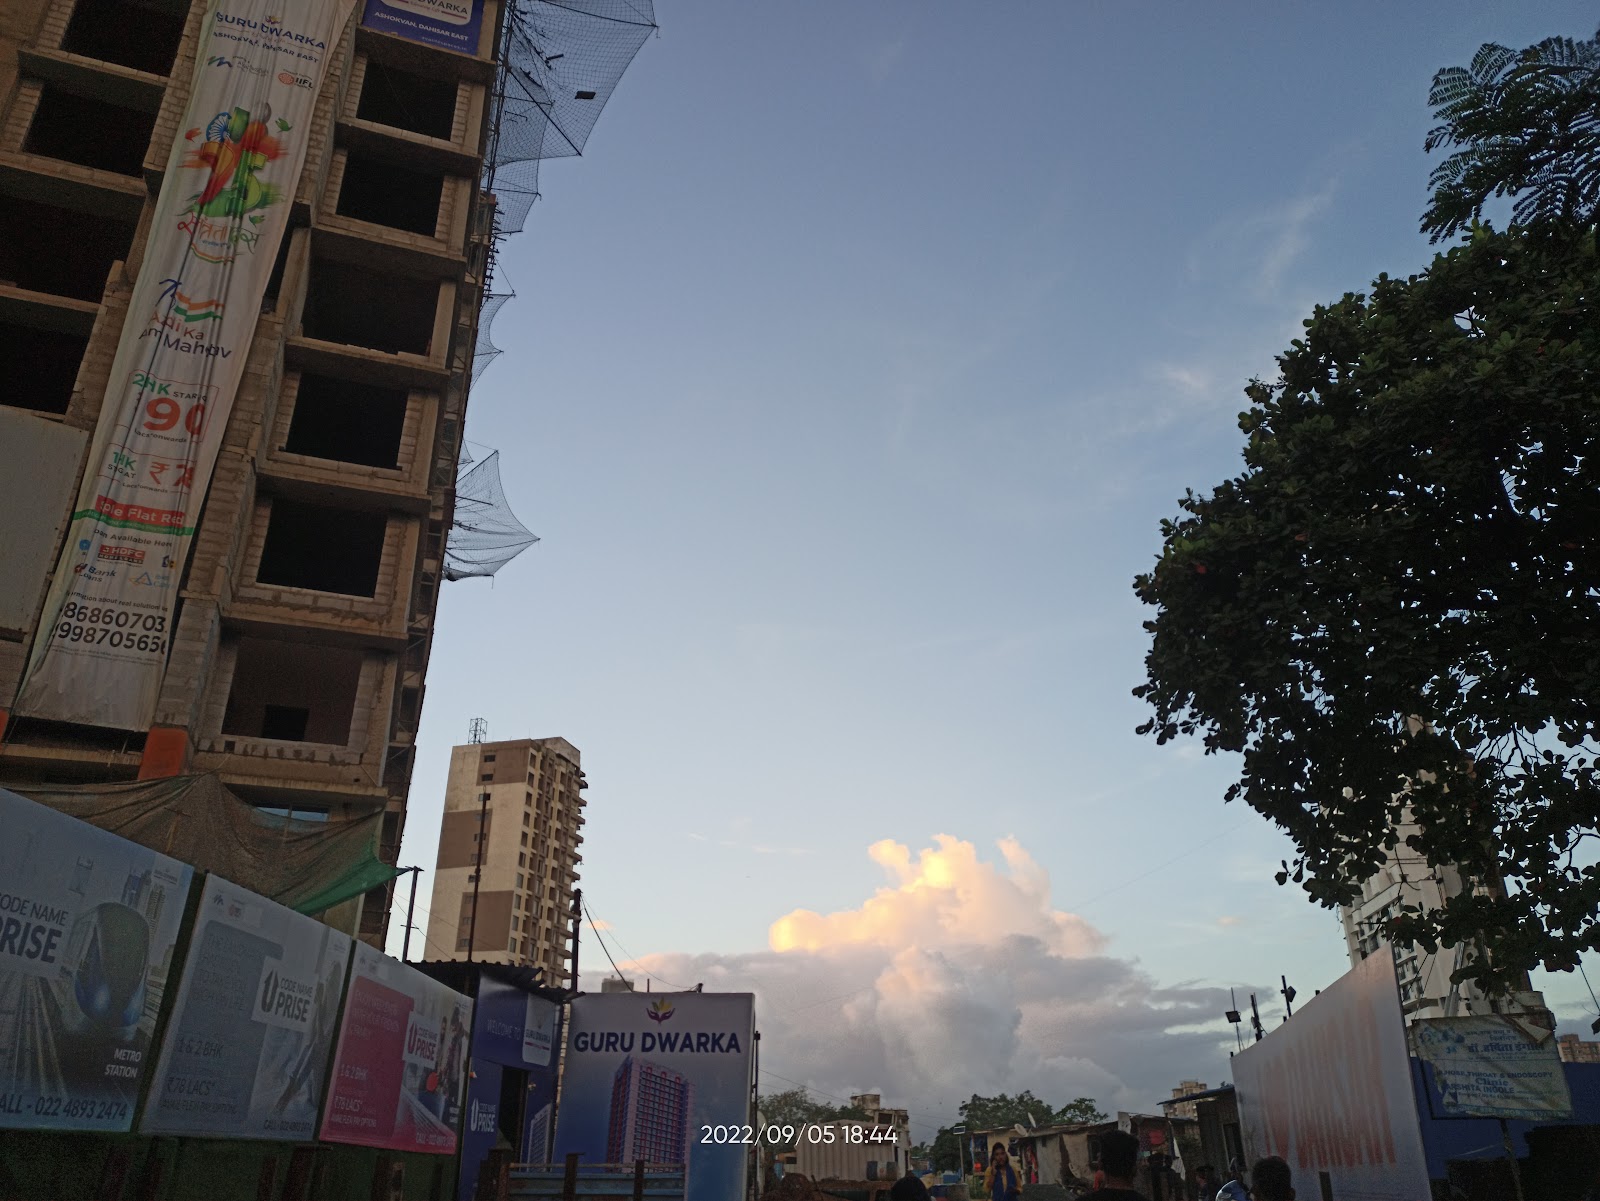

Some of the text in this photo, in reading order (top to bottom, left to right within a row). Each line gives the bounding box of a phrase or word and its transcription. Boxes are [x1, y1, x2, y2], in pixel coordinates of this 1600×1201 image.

[418, 23, 451, 37] DAHISAR
[450, 32, 469, 42] EAST
[296, 53, 319, 63] EAST
[295, 77, 314, 90] IIFL
[184, 325, 205, 341] Ka
[128, 508, 156, 521] Flat
[110, 533, 152, 546] Available
[111, 547, 144, 558] HDFC
[88, 563, 117, 578] Bank
[61, 601, 168, 634] 86860703
[31, 903, 69, 927] NAME
[280, 977, 297, 993] CODE
[203, 1042, 224, 1058] BHK
[573, 1031, 741, 1054] GURU DWARKA
[114, 1048, 142, 1063] METRO
[104, 1063, 139, 1079] STATION
[1507, 1071, 1553, 1079] ENDOSCOPY
[1447, 1083, 1481, 1093] ARSHITA
[1475, 1077, 1509, 1087] Clinic
[34, 1096, 60, 1117] 022
[63, 1099, 95, 1119] 4893
[99, 1102, 128, 1121] 2474
